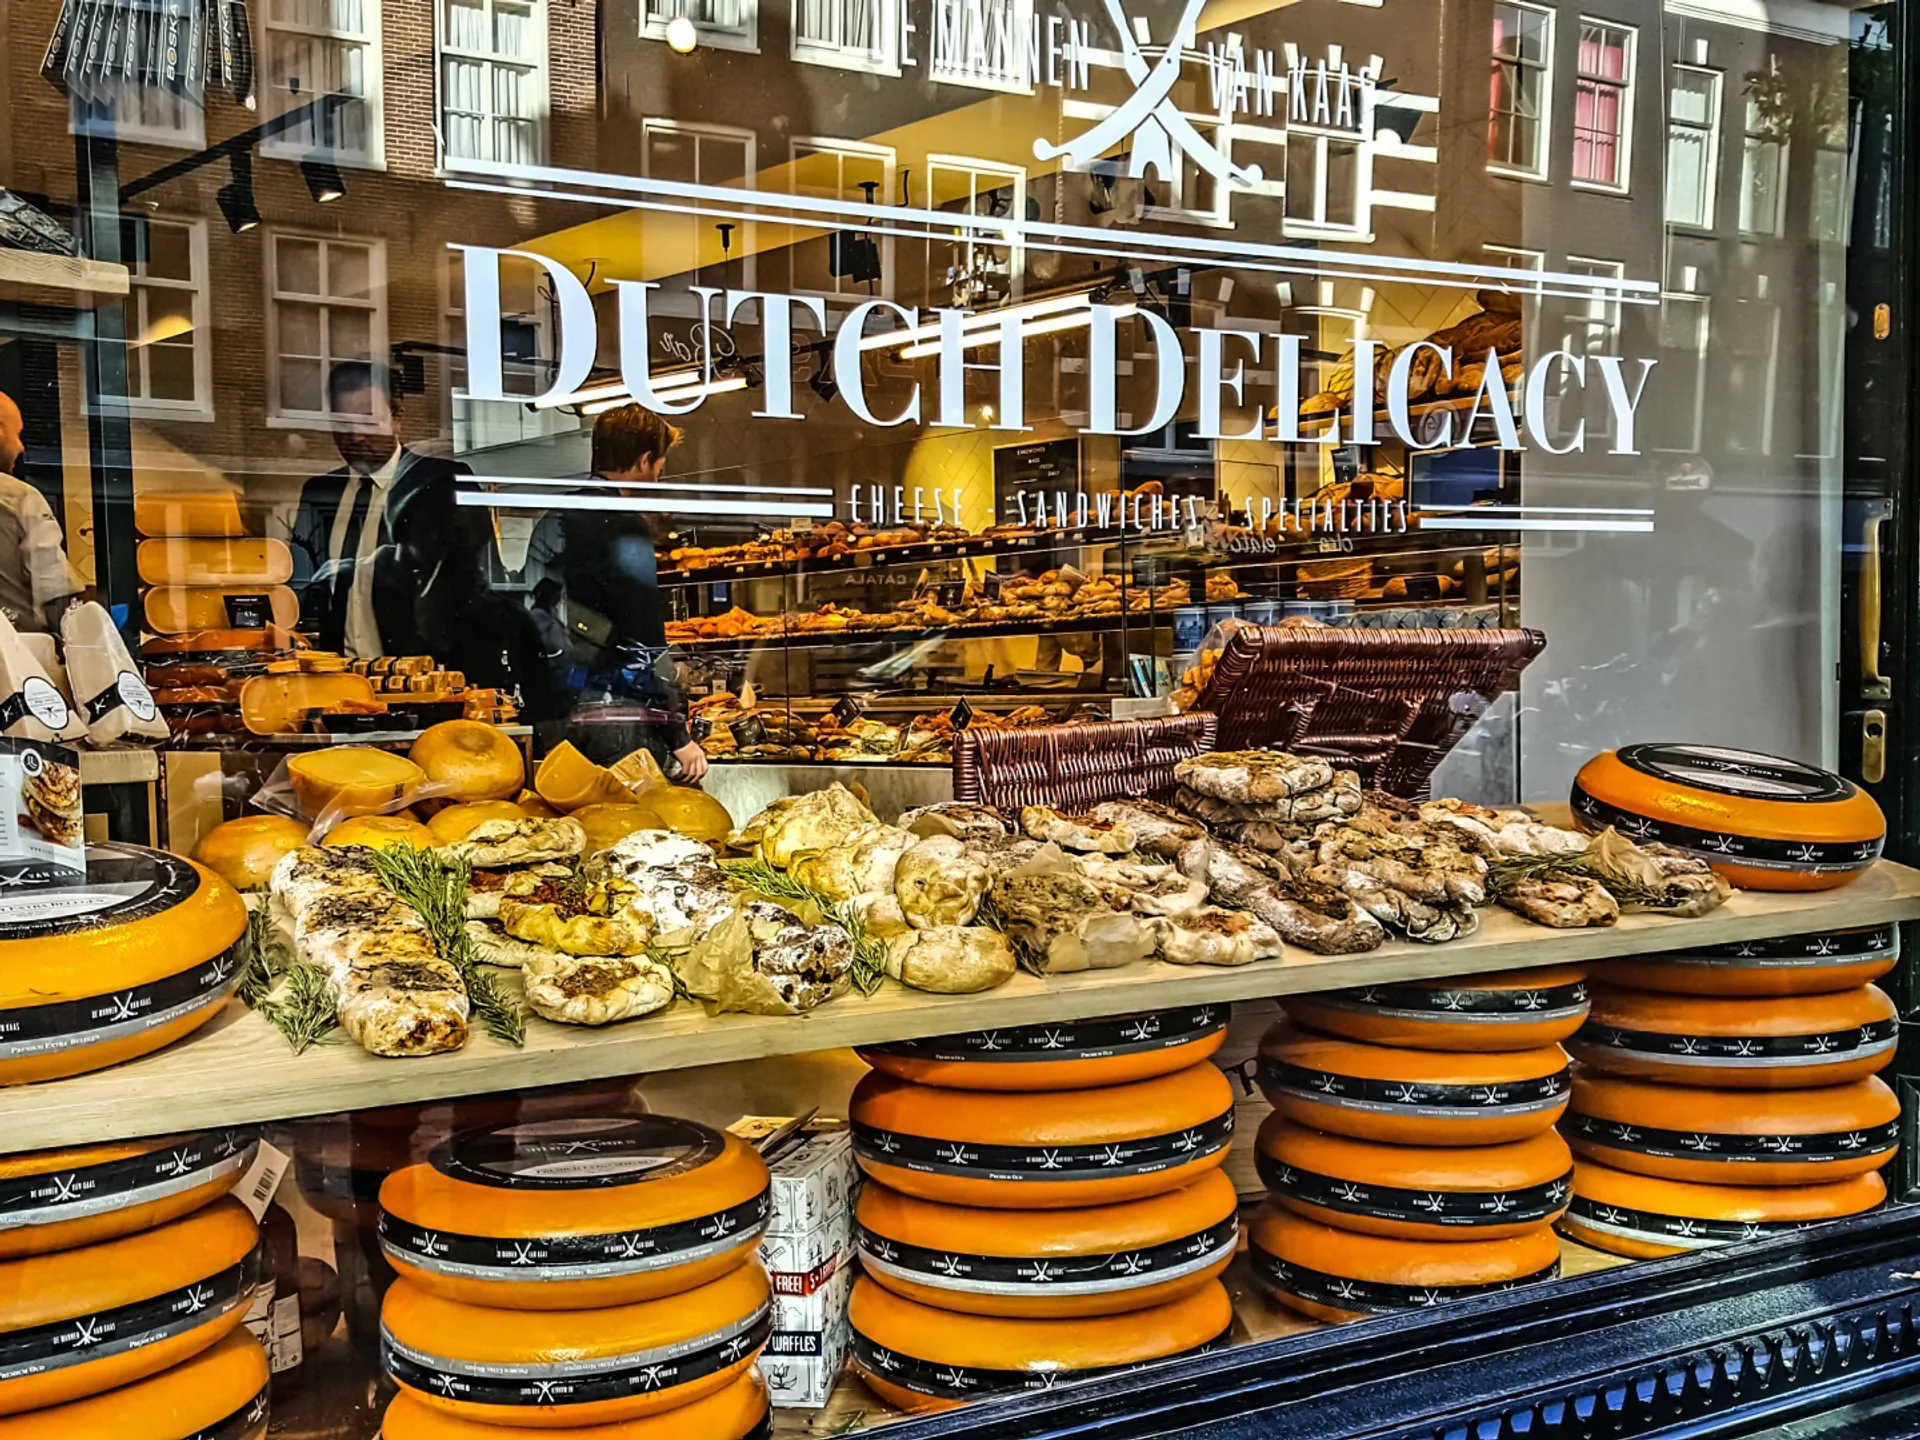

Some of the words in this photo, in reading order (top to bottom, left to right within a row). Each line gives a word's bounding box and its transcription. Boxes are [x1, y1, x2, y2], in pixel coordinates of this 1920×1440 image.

[165, 3, 182, 82] BOSKA
[222, 4, 234, 82] BOSKA
[936, 0, 1088, 91] MANNEN
[1207, 40, 1273, 117] VAN
[446, 242, 1034, 432] DUTCH
[1078, 303, 1659, 456] DELICACY
[851, 484, 965, 527] CHEESE
[1017, 490, 1198, 532] SANDWICHES
[1244, 496, 1408, 534] SPECIALTIES
[775, 1274, 803, 1293] FREE!
[771, 1335, 817, 1353] WAFFLES
